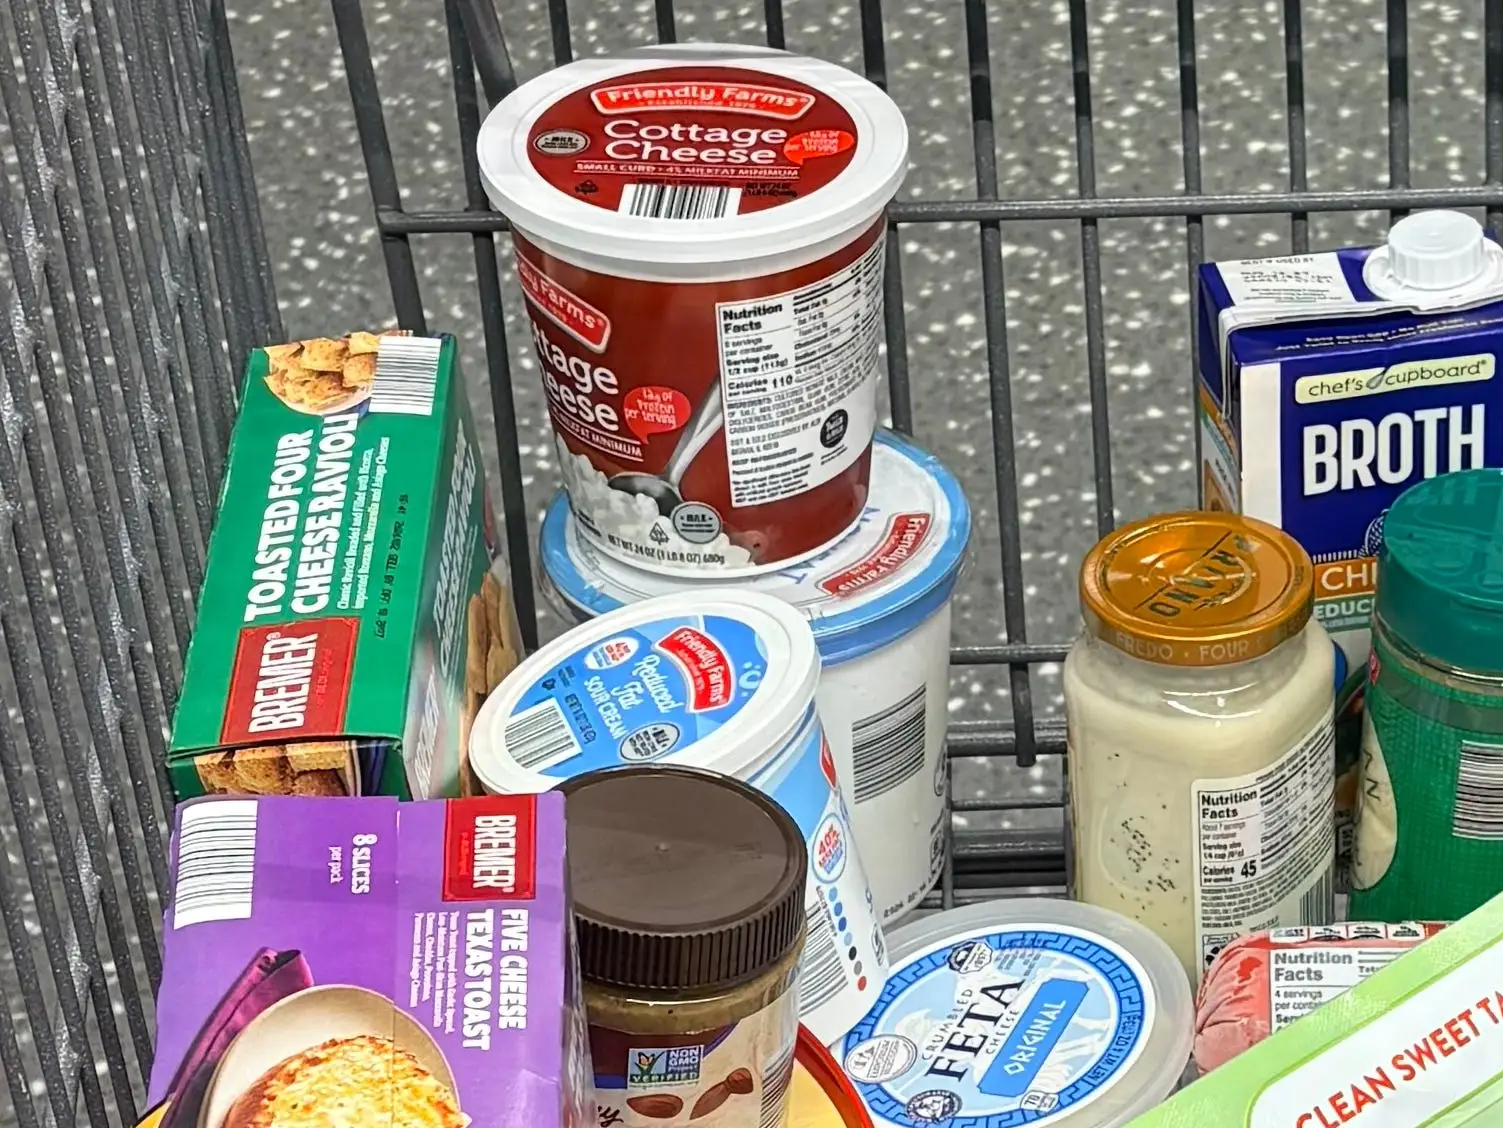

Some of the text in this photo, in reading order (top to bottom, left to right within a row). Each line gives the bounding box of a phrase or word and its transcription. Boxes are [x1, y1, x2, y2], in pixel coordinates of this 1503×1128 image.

[607, 84, 794, 108] Friendly Farms
[604, 119, 788, 147] Cottage
[576, 162, 617, 173] SMALL
[604, 141, 777, 165] Cheese
[723, 303, 783, 320] Nutrition
[724, 321, 762, 335] Facts
[727, 377, 768, 391] Calories
[1307, 361, 1483, 399] chef's cupboard
[1302, 403, 1487, 497] BROTH
[244, 427, 315, 623] TOASTED FOUR
[291, 508, 348, 615] CHEESE
[247, 632, 319, 734] BREMER
[610, 680, 645, 712] Fat
[631, 654, 684, 715] Reduced
[582, 674, 629, 741] SOUR CREAM
[1201, 788, 1258, 807] Nutrition
[1201, 806, 1239, 820] Facts
[471, 814, 518, 890] BREMER
[350, 846, 376, 895] SLICES
[1203, 861, 1258, 879] Calories 45
[498, 908, 529, 1030] FIVE CHEESE
[1274, 952, 1353, 965] Nutrition
[461, 907, 495, 1052] TEXAS TOAST
[1274, 967, 1324, 982] Facts
[1282, 990, 1323, 1000] servings
[920, 986, 975, 1062] CRUMBLED
[924, 978, 1027, 1082] FETA
[1003, 998, 1068, 1078] ORIGINAL
[668, 1049, 699, 1058] NON
[1390, 1008, 1483, 1083] SWEET
[668, 1057, 699, 1067] GMO
[629, 1072, 699, 1083] VERIFIED
